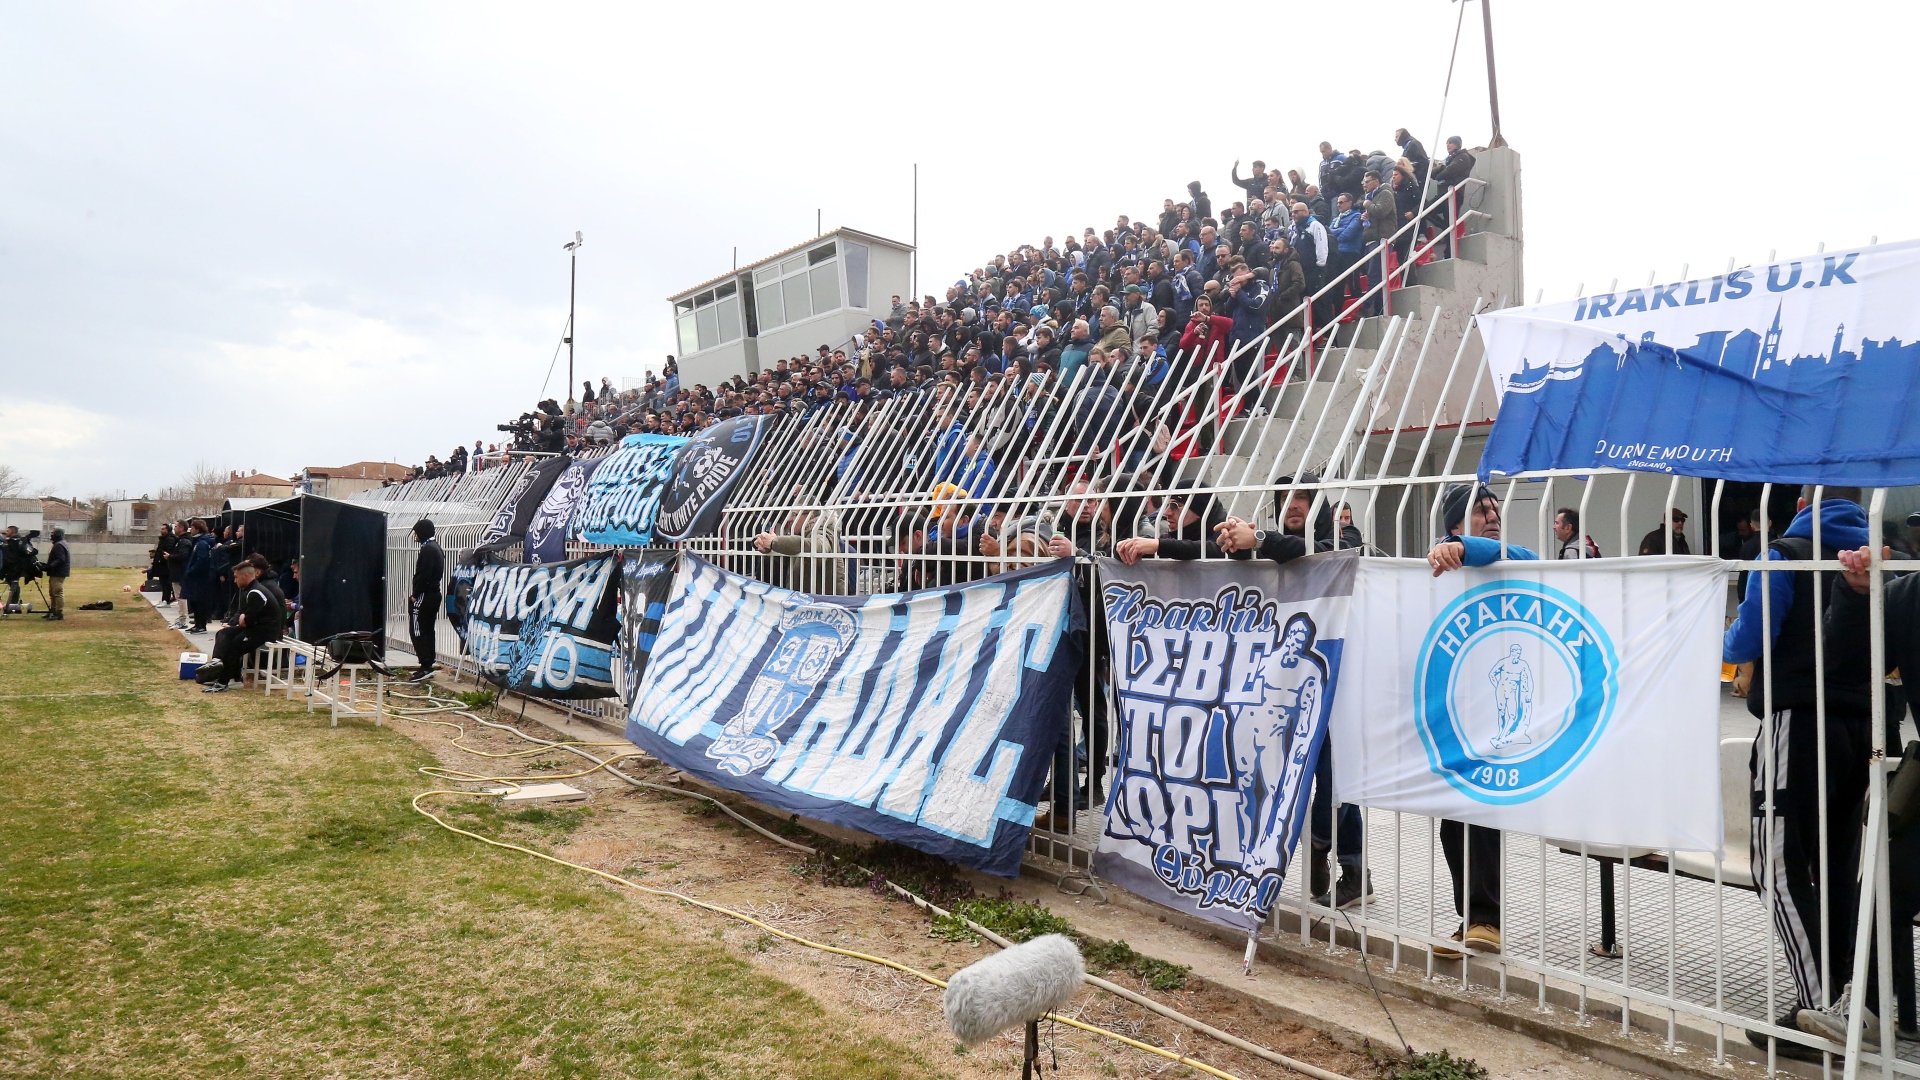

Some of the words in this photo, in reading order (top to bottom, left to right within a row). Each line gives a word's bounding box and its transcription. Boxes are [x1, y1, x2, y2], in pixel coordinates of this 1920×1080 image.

[1573, 269, 1755, 322] IRAKLIS
[1766, 252, 1860, 293] U.K
[1594, 439, 1734, 463] OURNEMOUTH
[1627, 459, 1667, 470] ENGLAND
[671, 491, 699, 531] WHITE
[696, 454, 739, 500] PRIDE
[531, 625, 579, 691] 10
[1436, 595, 1594, 659] ΗΡΑΚΛΗΣ
[1470, 764, 1521, 787] 1908
[1154, 843, 1251, 907] Θύρα
